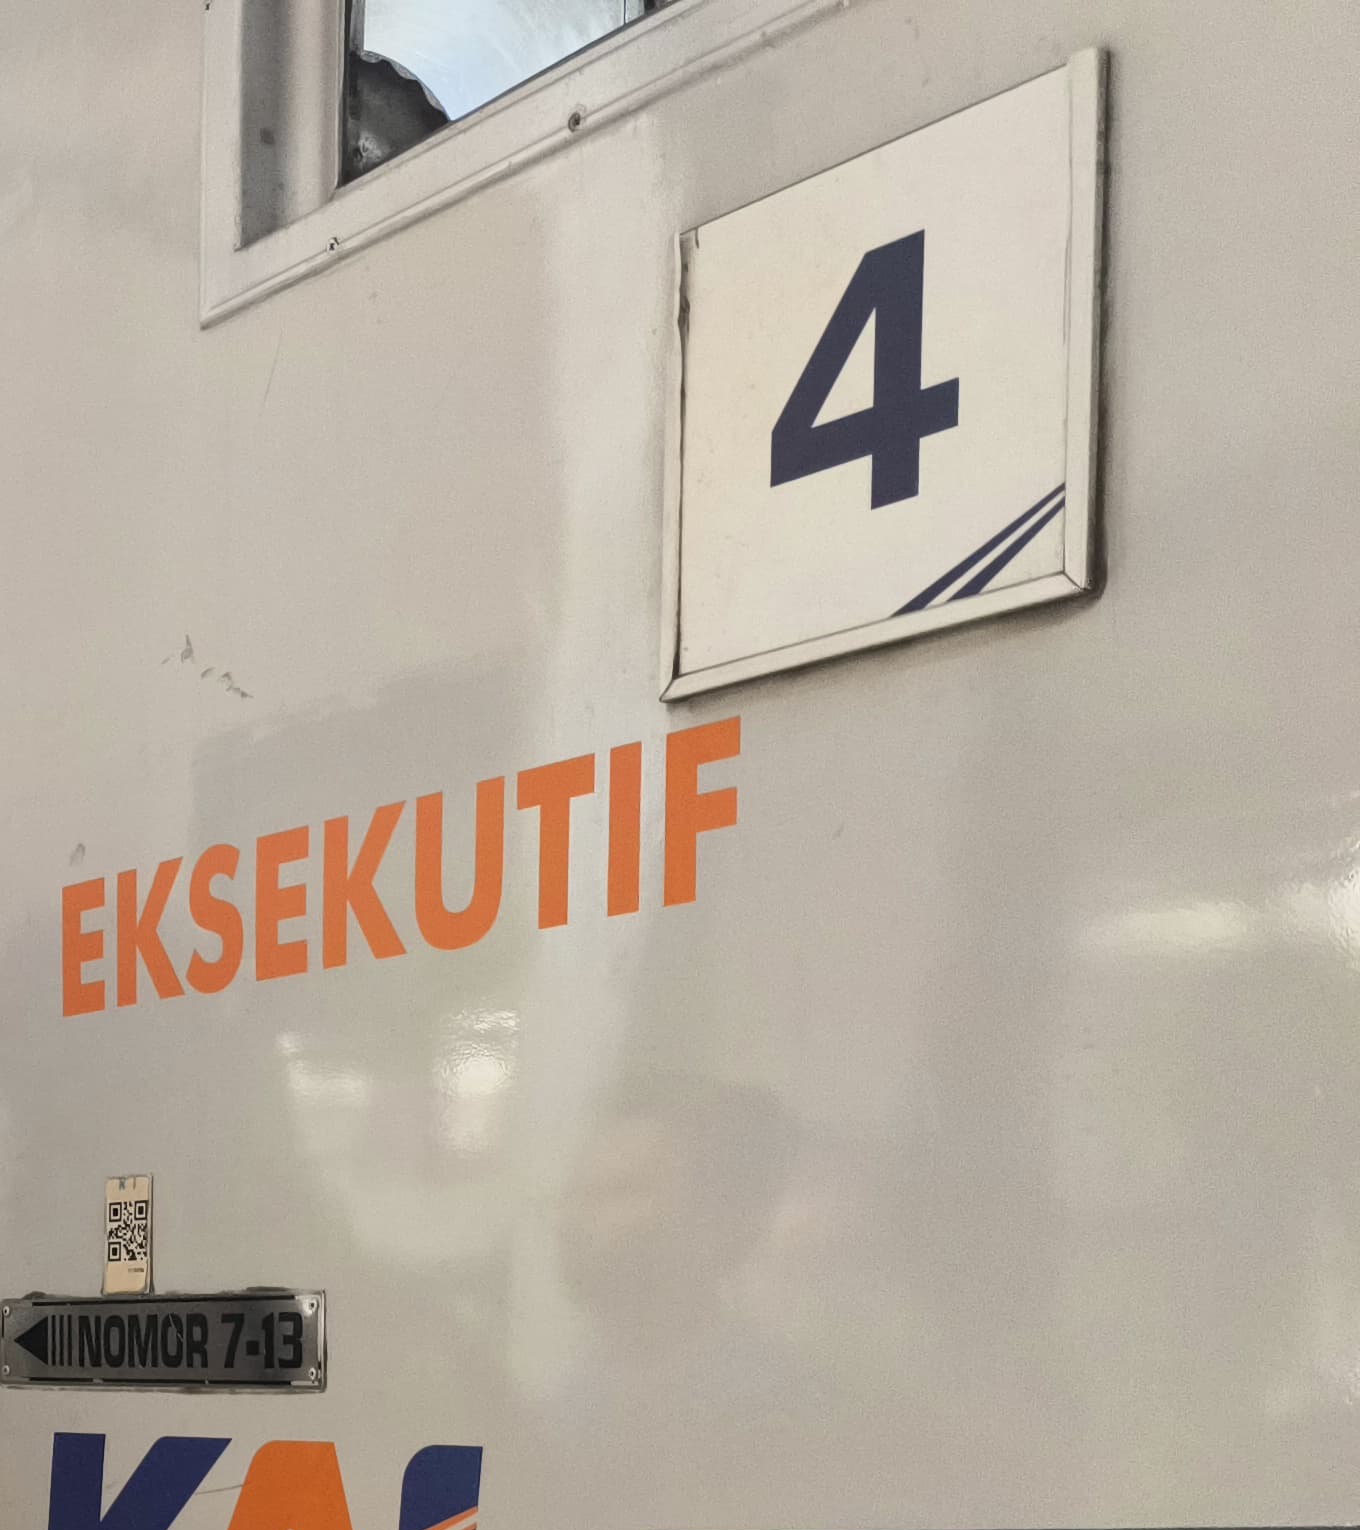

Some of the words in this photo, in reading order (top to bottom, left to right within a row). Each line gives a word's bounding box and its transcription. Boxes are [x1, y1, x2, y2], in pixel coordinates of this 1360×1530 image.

[770, 228, 960, 511] 4
[60, 715, 742, 1018] EKSEKUTIF
[77, 1312, 210, 1370] NOMOR
[220, 1311, 304, 1370] 7-13
